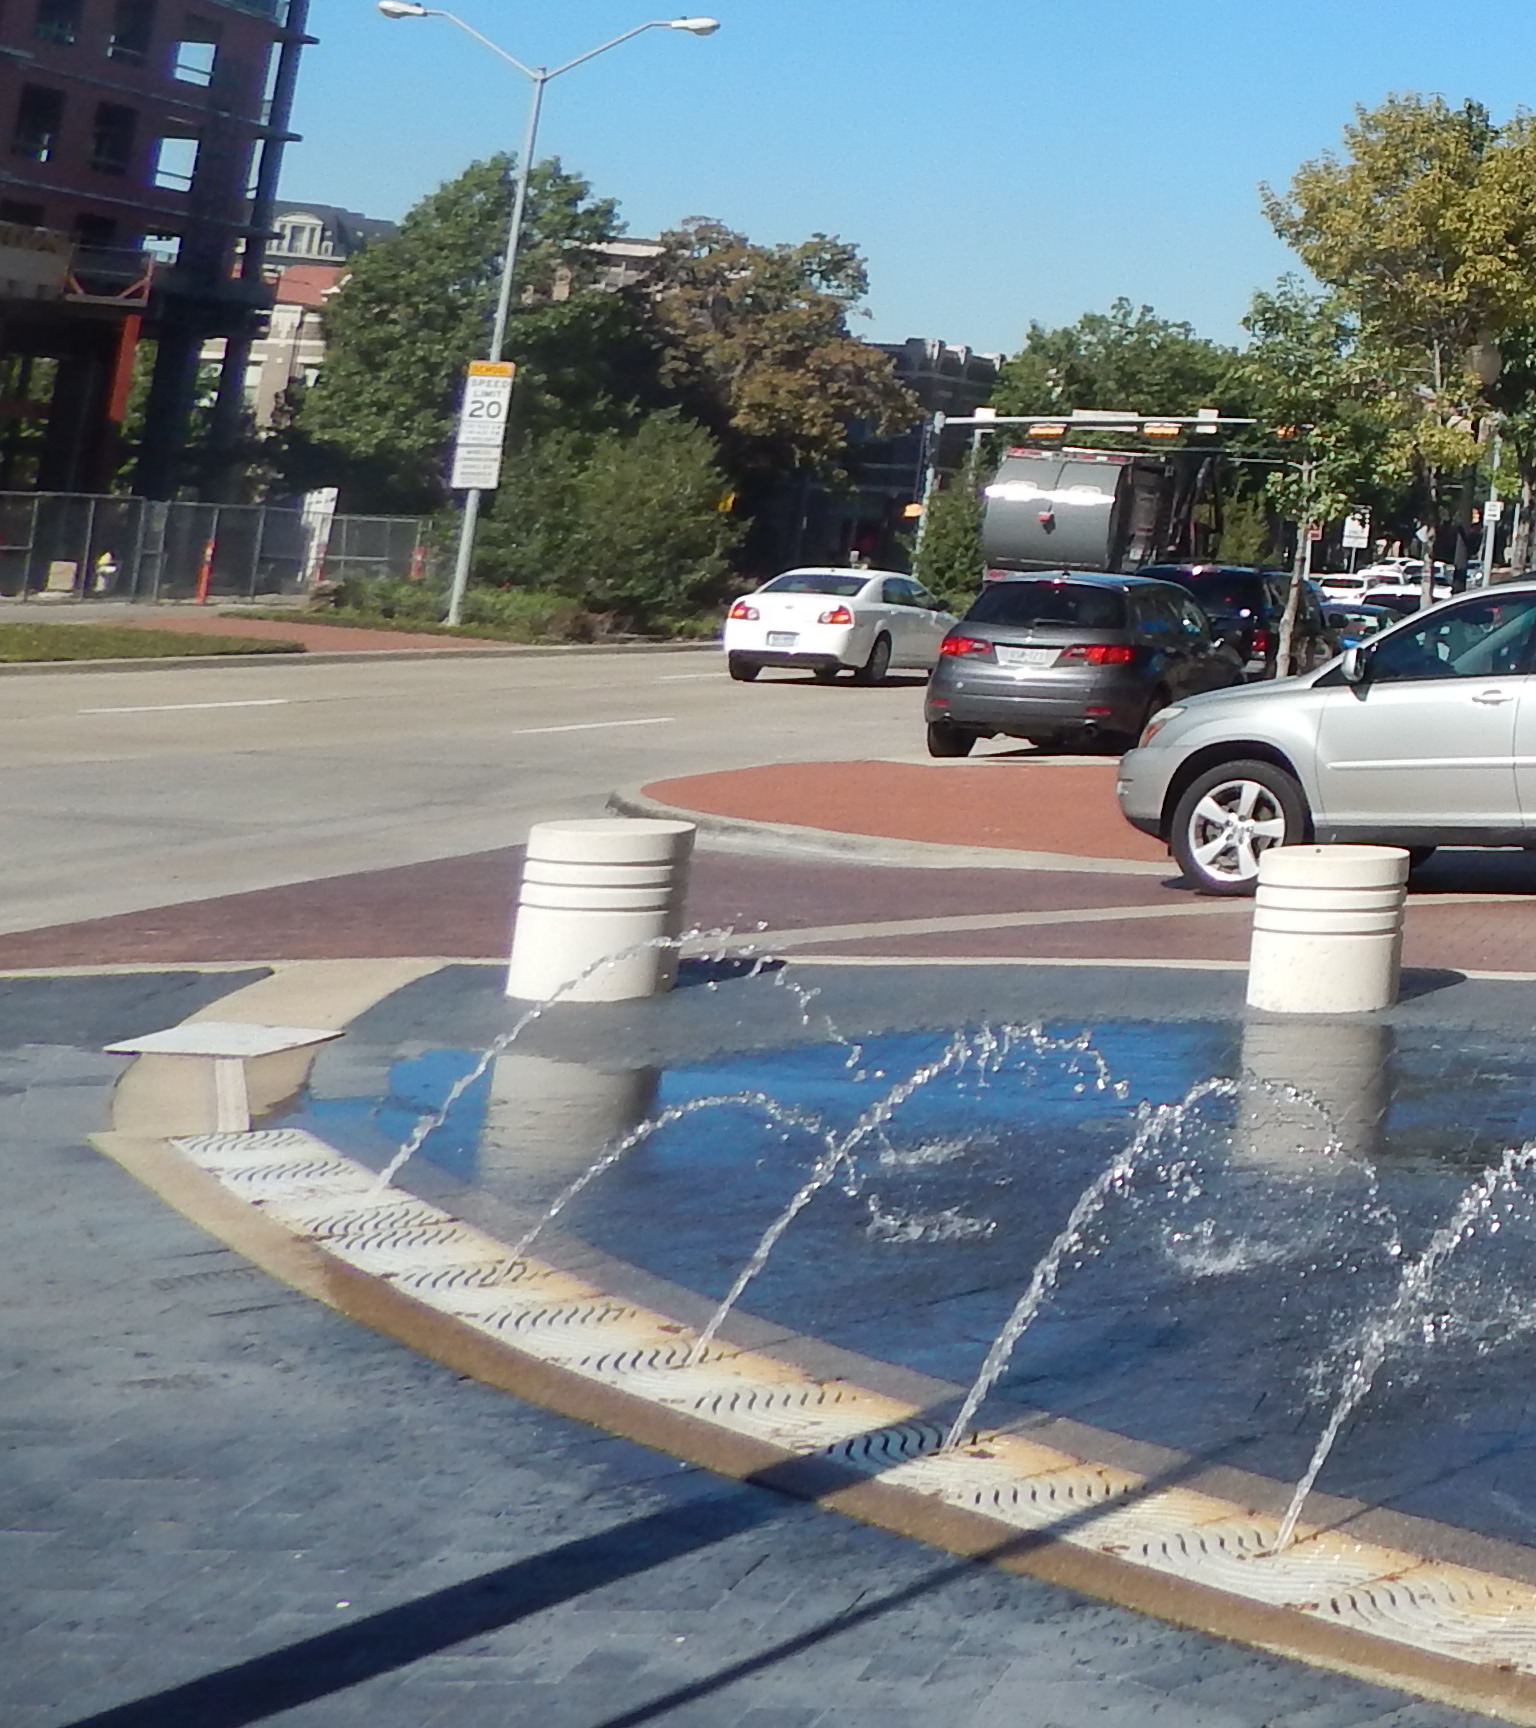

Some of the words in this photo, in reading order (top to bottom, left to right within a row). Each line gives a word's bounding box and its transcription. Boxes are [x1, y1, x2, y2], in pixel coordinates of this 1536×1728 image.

[471, 379, 510, 388] SPEED
[473, 390, 502, 398] LIMIT
[468, 400, 502, 419] 20
